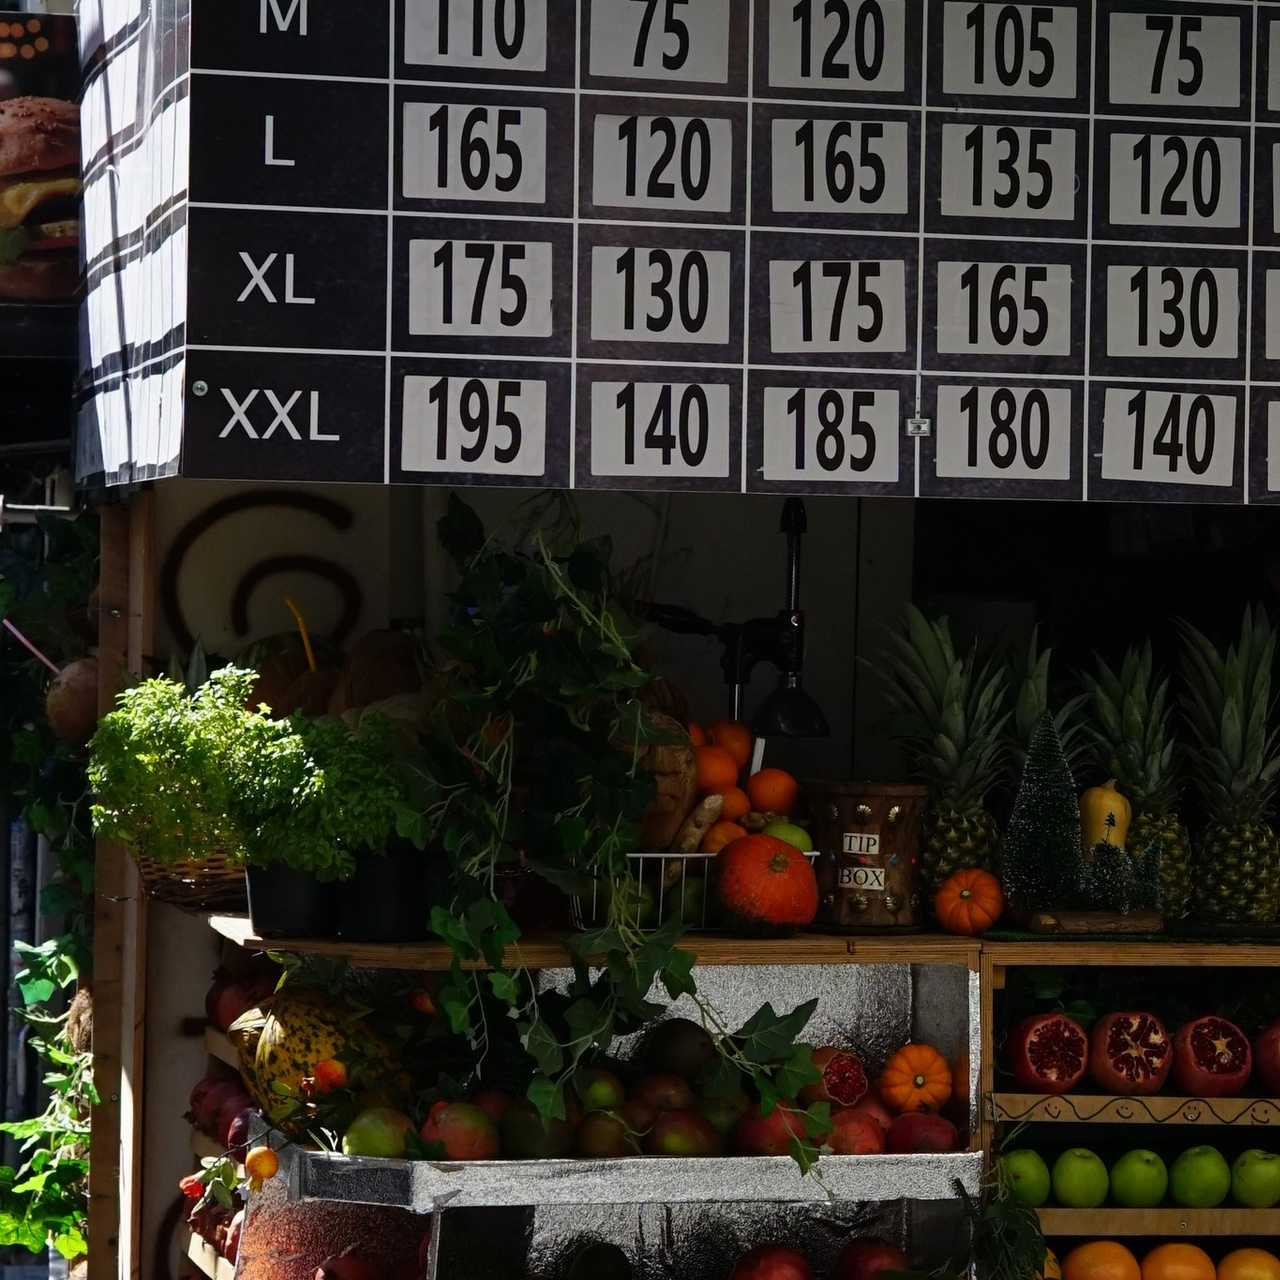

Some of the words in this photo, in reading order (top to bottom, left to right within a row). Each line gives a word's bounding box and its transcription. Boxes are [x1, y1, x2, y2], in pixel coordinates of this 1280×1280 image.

[967, 4, 1054, 88] 105
[1146, 16, 1201, 96] 75
[265, 115, 295, 166] L
[429, 105, 522, 192] 165
[619, 117, 710, 200] 120
[795, 122, 885, 204] 165
[965, 127, 1053, 209] 135
[1133, 135, 1221, 217] 120
[237, 252, 315, 304] XL
[433, 242, 527, 327] 175
[617, 248, 708, 333] 130
[793, 262, 883, 343] 175
[961, 264, 1048, 347] 165
[1131, 268, 1218, 349] 130
[219, 389, 339, 440] XXL
[429, 378, 522, 463] 195
[617, 383, 708, 467] 140
[787, 389, 875, 471] 185
[960, 387, 1049, 470] 180
[1128, 391, 1215, 474] 140
[841, 869, 883, 887] BOX
[845, 835, 877, 853] TIP
